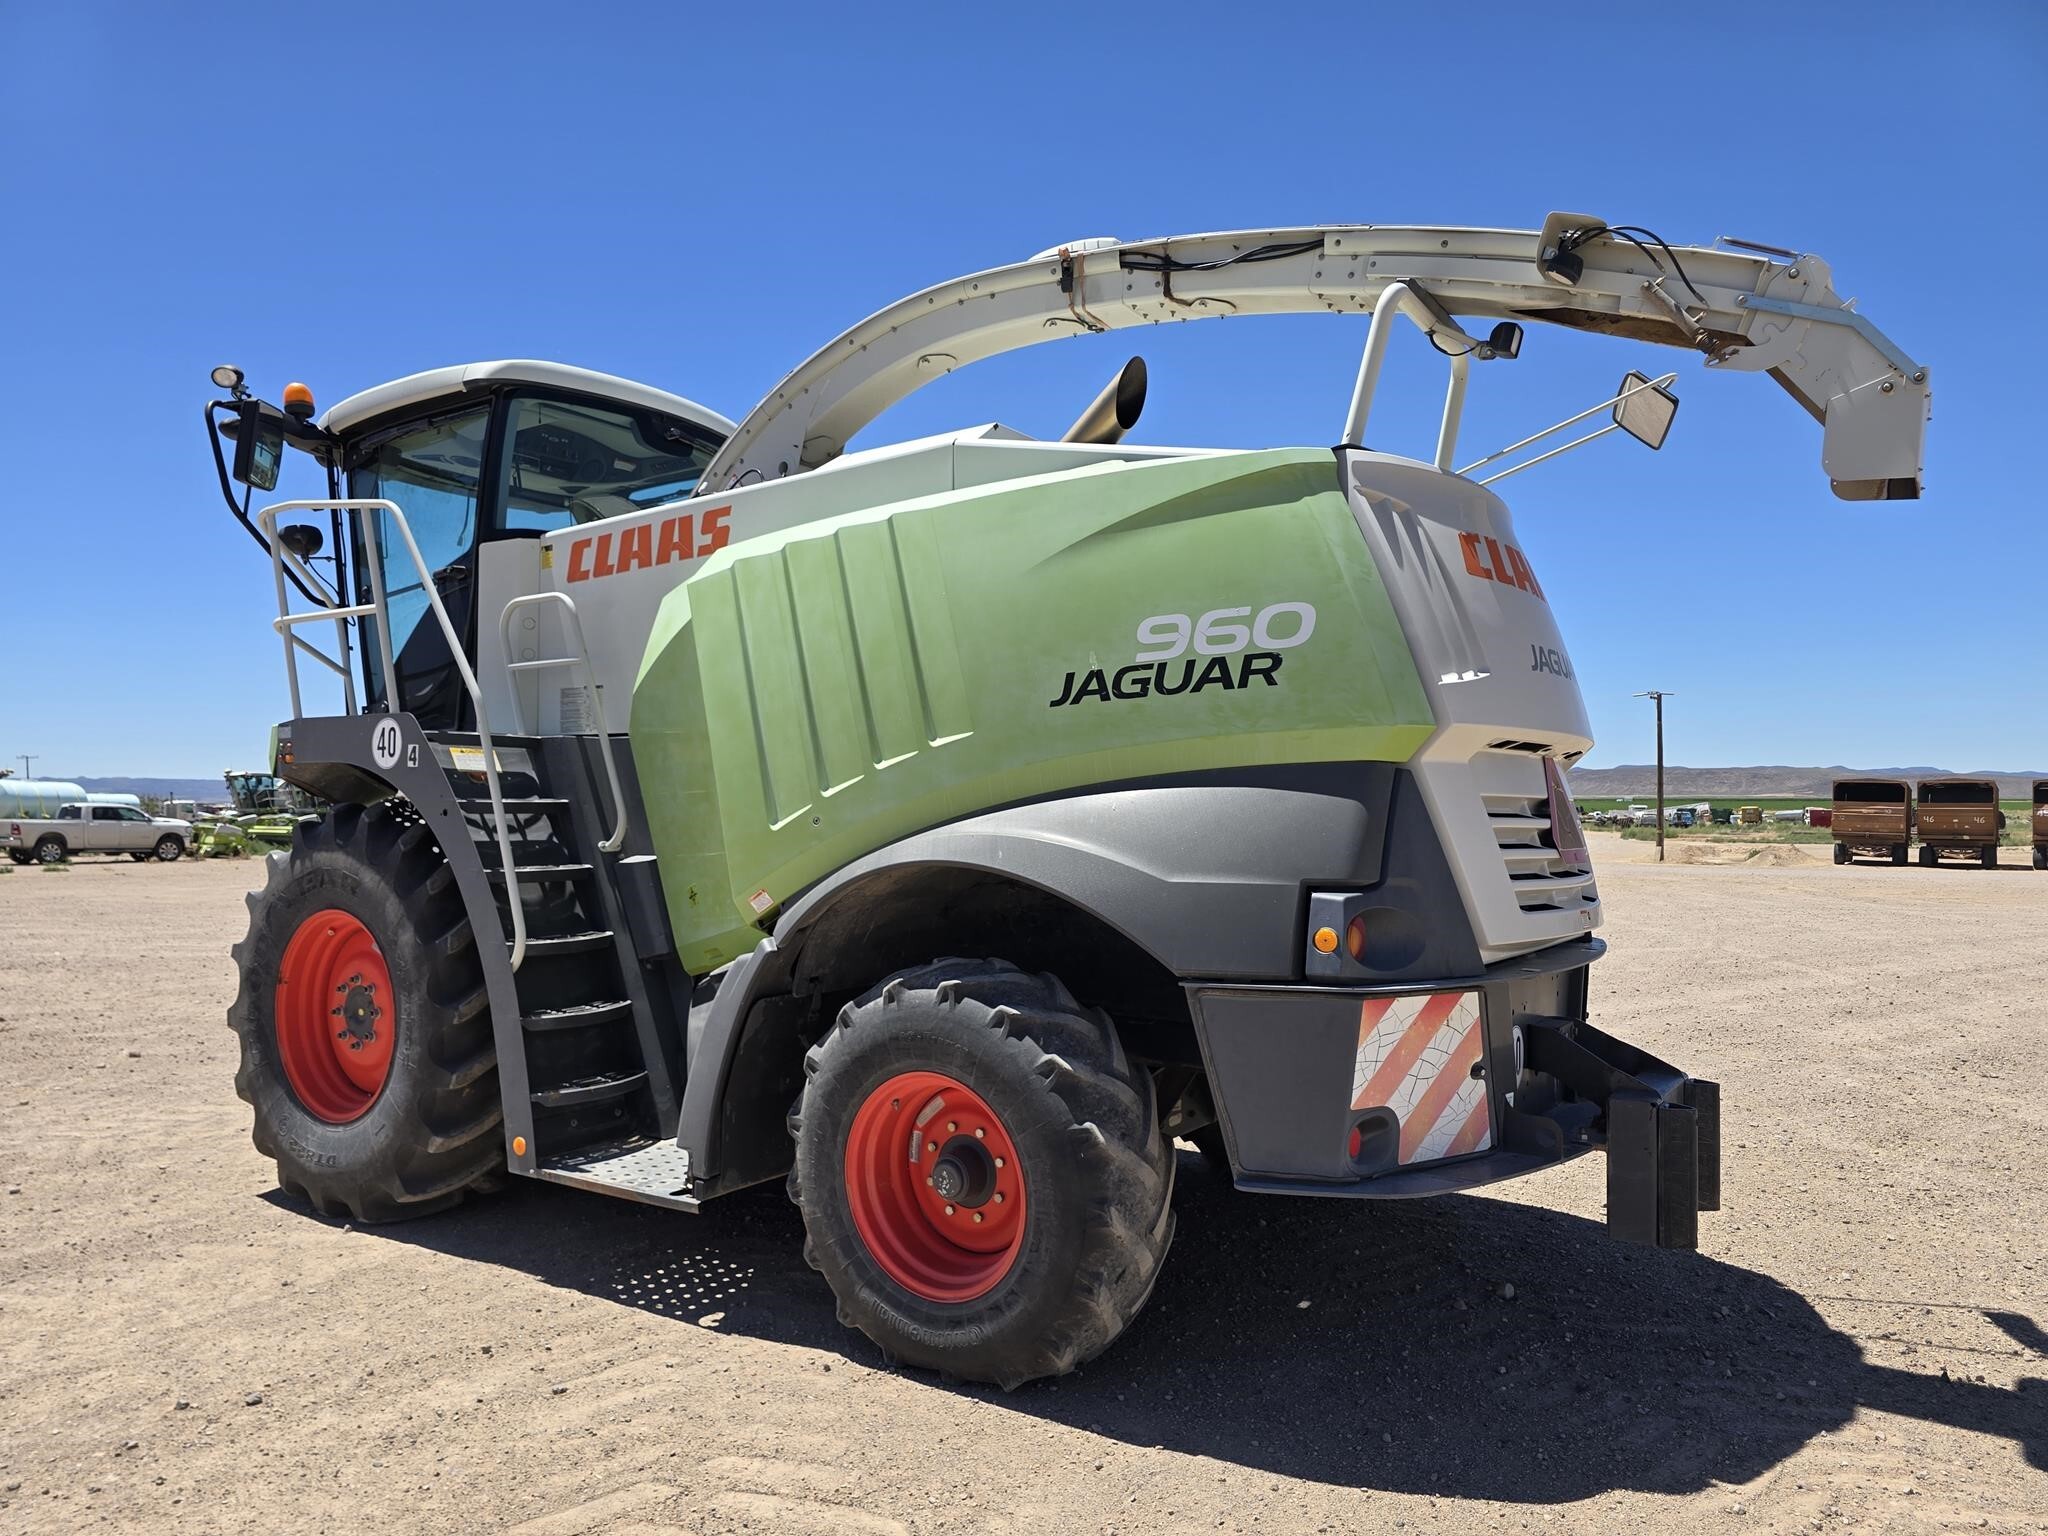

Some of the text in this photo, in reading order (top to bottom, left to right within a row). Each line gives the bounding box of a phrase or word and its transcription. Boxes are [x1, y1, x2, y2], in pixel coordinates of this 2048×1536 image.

[567, 505, 732, 583] CLAAS
[1458, 532, 1546, 604] CLA
[1136, 602, 1317, 662] 960
[1049, 652, 1283, 708] JAGUAR
[1531, 644, 1573, 681] JAGU
[377, 727, 396, 758] 40
[409, 745, 417, 766] 4
[1923, 815, 1935, 823] 46
[1973, 816, 1985, 824] 46
